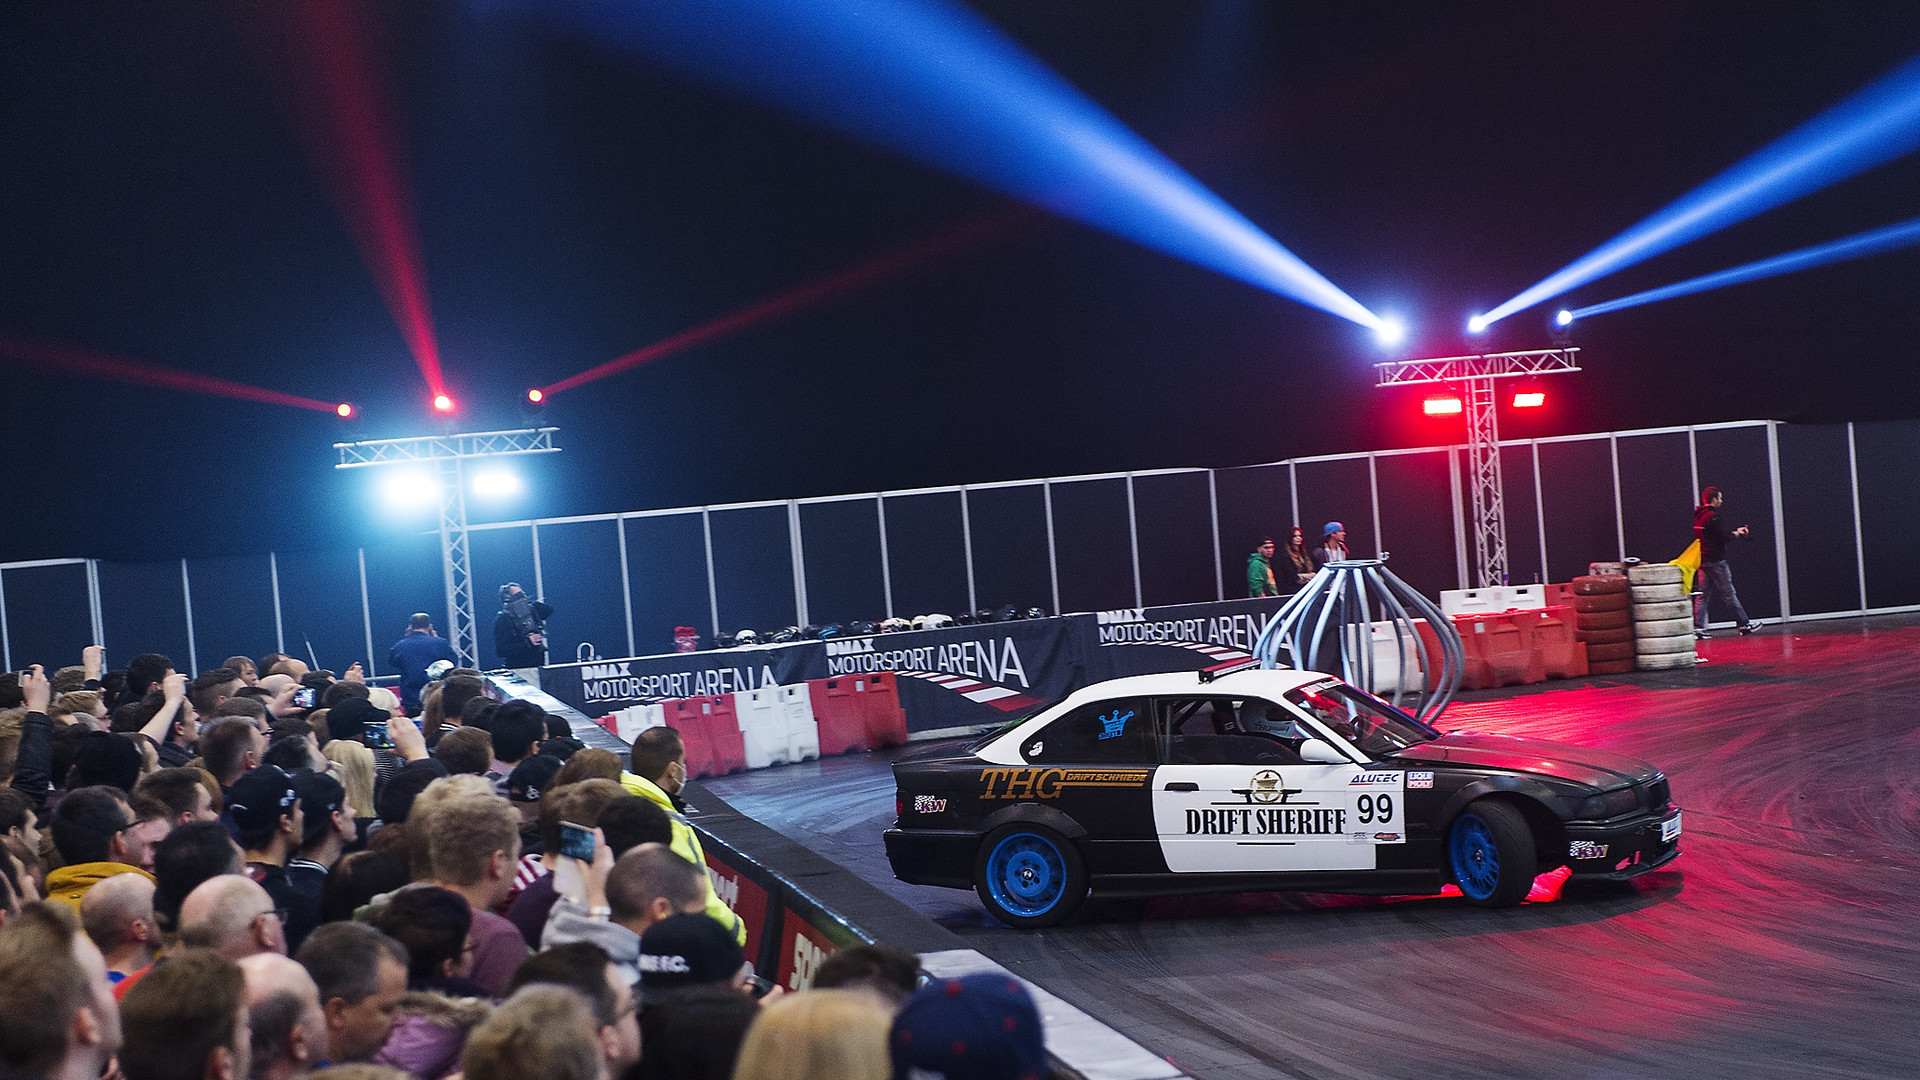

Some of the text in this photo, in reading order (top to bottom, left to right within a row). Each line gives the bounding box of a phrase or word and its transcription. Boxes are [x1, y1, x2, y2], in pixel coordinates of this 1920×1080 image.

[1097, 608, 1147, 624] DMAX
[1099, 618, 1206, 643] MOTORSPORT
[826, 638, 875, 656] DMAX
[581, 662, 631, 680] DMAX
[828, 636, 1030, 688] MOTORSPORT ARENA
[584, 672, 692, 699] MOTORSPORT
[979, 768, 1148, 799] THG DRIFTSCHMIEDE
[1351, 773, 1400, 783] ALUTEC
[920, 799, 947, 814] KW
[1357, 793, 1393, 825] 99
[1185, 808, 1347, 835] DRIFT SHERIFF
